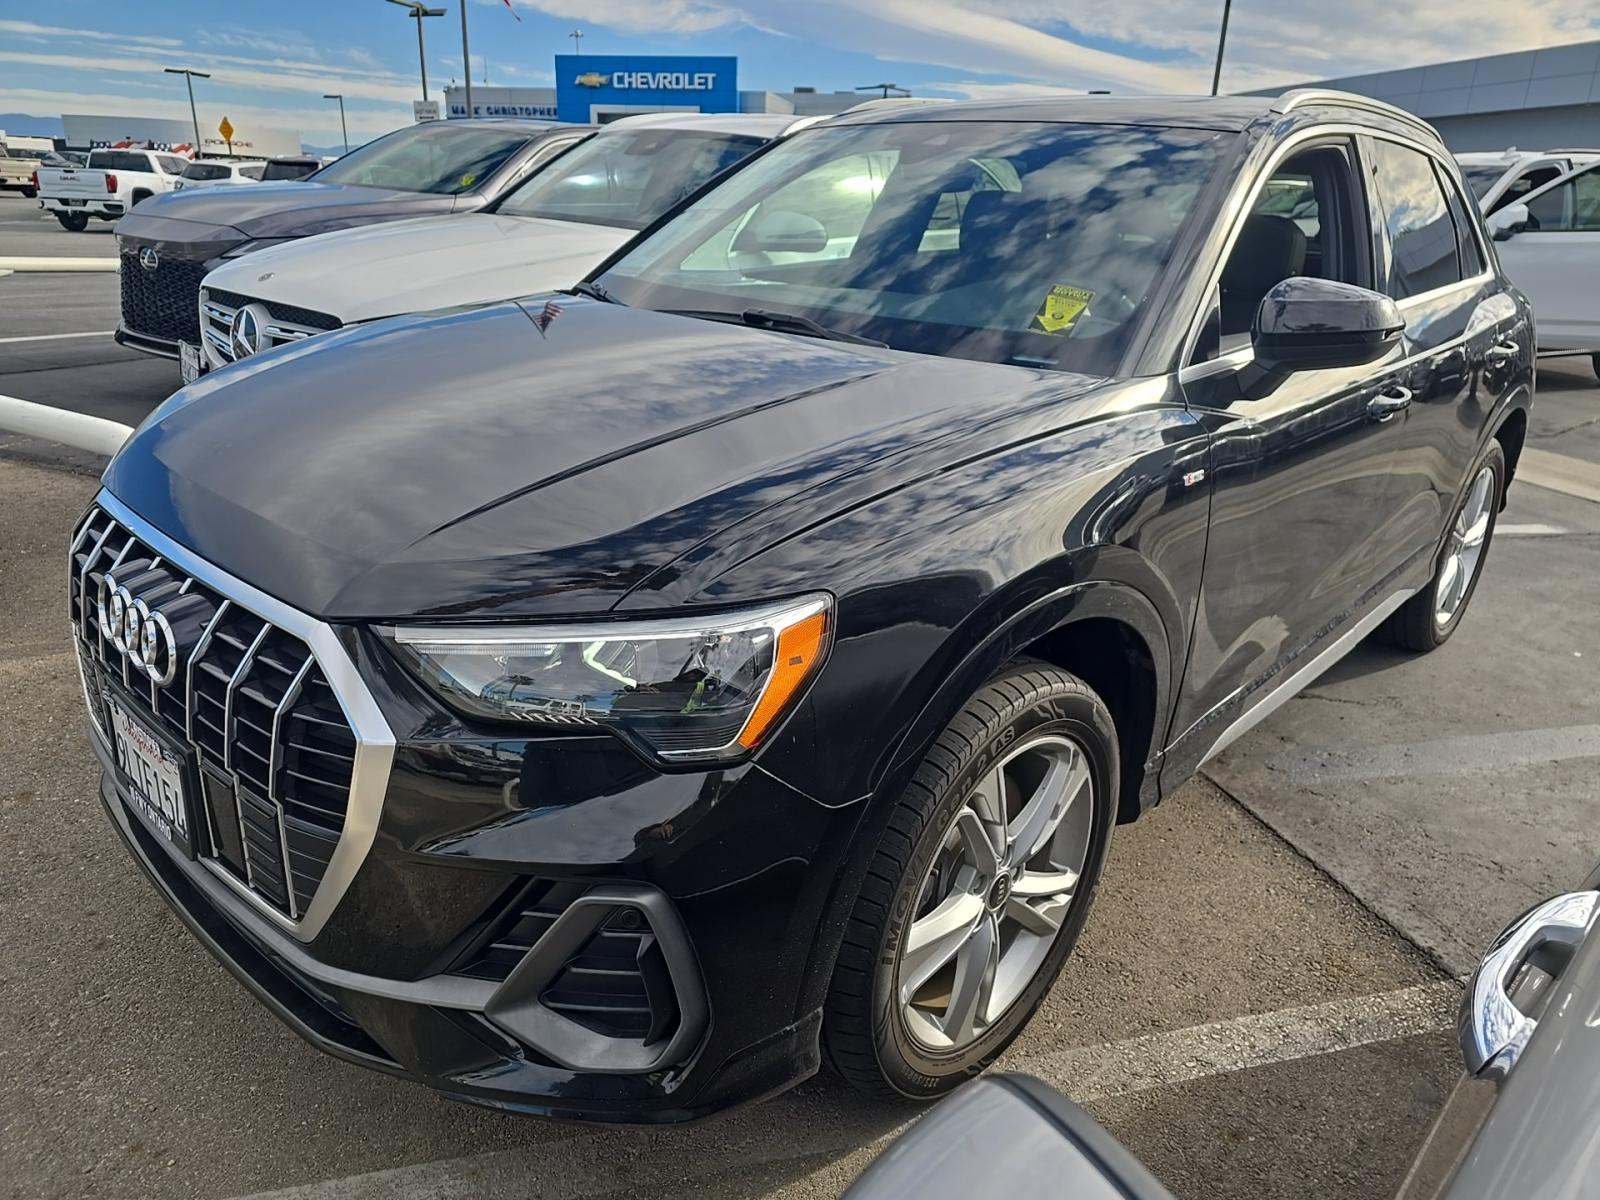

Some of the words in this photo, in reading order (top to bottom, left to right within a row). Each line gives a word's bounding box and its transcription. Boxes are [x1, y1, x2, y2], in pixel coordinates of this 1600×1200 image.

[612, 71, 716, 90] CHEVROLET
[451, 105, 481, 116] MAK
[977, 753, 988, 777] 2
[993, 727, 1015, 757] AS
[115, 730, 189, 839] 9LTF154
